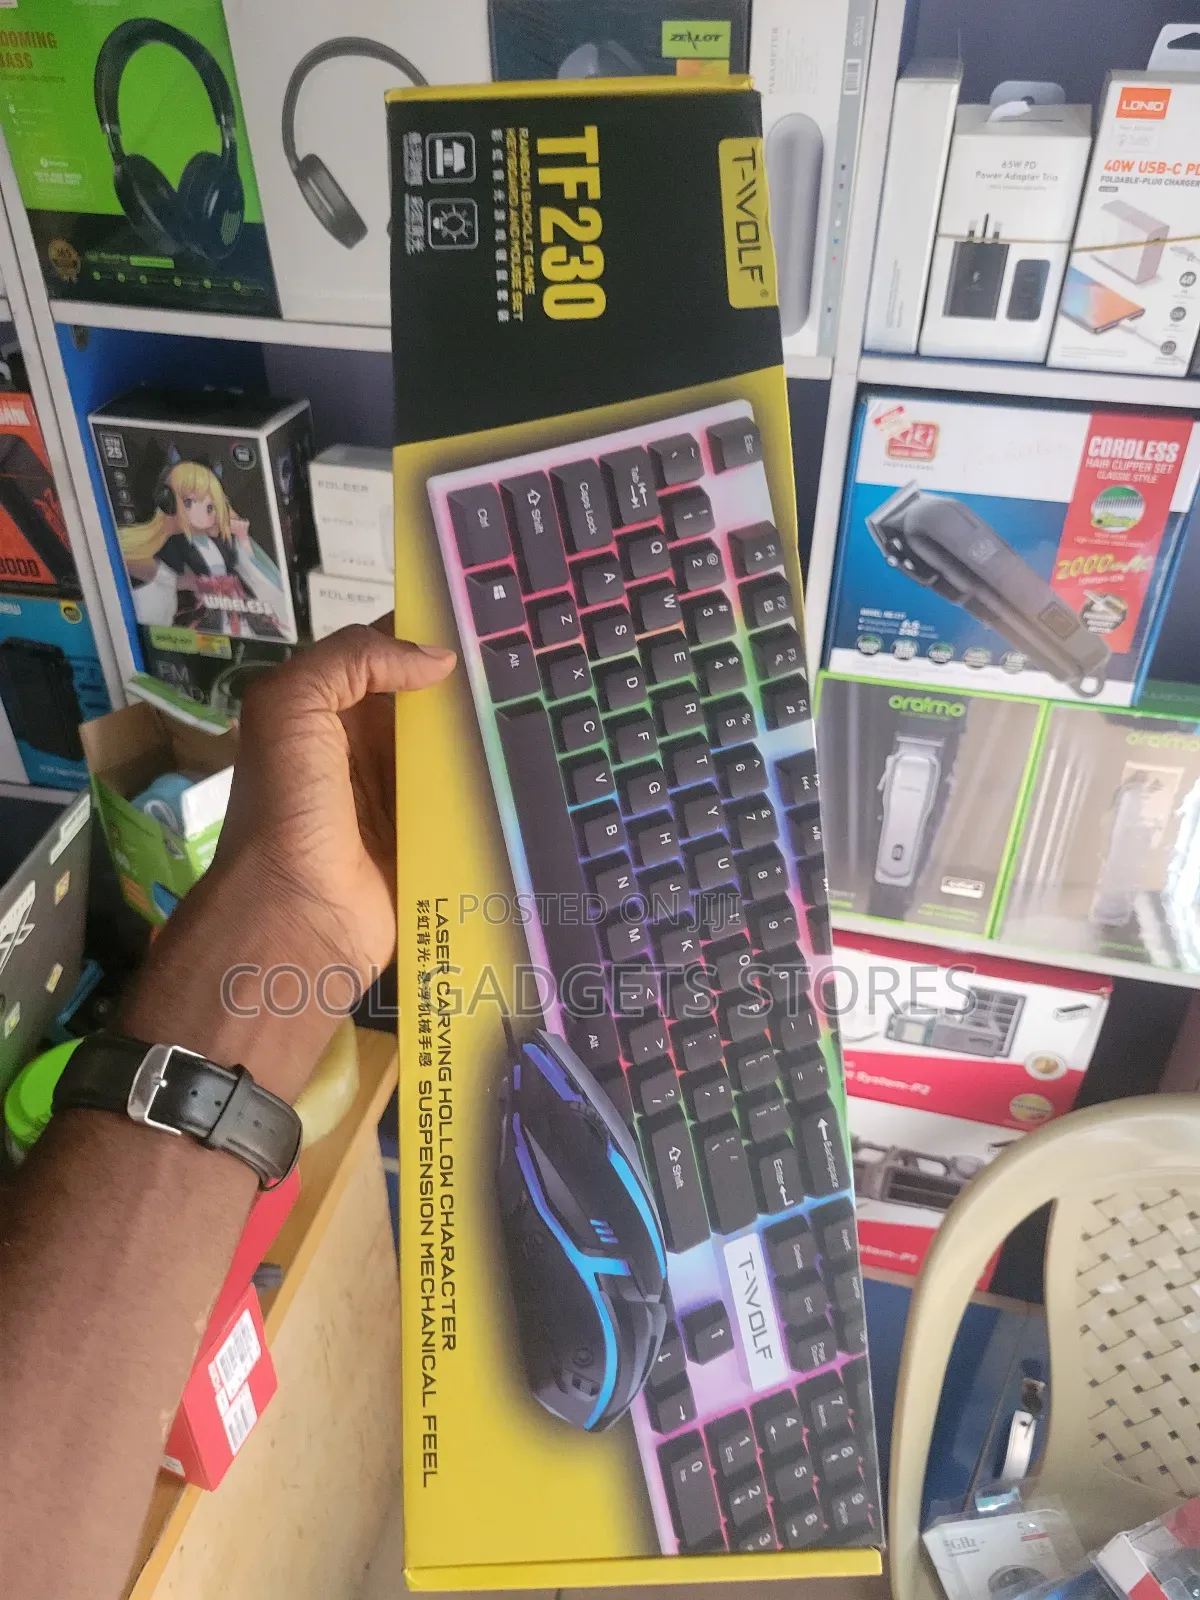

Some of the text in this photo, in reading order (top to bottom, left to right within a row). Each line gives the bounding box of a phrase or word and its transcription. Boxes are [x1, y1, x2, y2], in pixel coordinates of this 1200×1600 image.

[1121, 100, 1165, 113] LDNIO
[1024, 160, 1037, 170] PD
[1104, 159, 1135, 173] 40W
[1138, 160, 1183, 175] USB-C
[975, 170, 1059, 183] Power Adapter Trio
[1100, 175, 1163, 186] FOLDABLE-PLUG
[537, 125, 607, 321] TF230
[744, 435, 753, 454] Esc
[1087, 435, 1181, 463] CORDLESS
[1086, 457, 1174, 475] HAIR CLIPPER SET
[1132, 473, 1158, 484] STYLE
[580, 483, 597, 535] Caps Lock
[478, 509, 489, 527] Ctrl
[532, 509, 543, 534] Shift
[651, 542, 662, 554] Q
[693, 559, 702, 568] 2
[604, 573, 615, 583] A
[664, 594, 676, 607] W
[703, 608, 713, 616] 3
[561, 615, 572, 625] Z
[615, 625, 626, 635] S
[509, 654, 519, 668] Alt
[674, 652, 686, 663] E
[573, 668, 584, 679] X
[627, 677, 638, 688] D
[685, 703, 696, 715] R
[888, 695, 966, 718] oraimo
[584, 721, 595, 732] C
[726, 719, 736, 727] 5
[638, 732, 649, 740] F
[697, 755, 707, 764] T
[596, 773, 607, 782] V
[649, 782, 660, 794] G
[708, 806, 718, 815] Y
[606, 824, 617, 835] B
[660, 833, 671, 844] H
[718, 858, 729, 869] U
[618, 877, 629, 888] N
[769, 921, 778, 929] 9
[629, 928, 640, 942] M
[681, 940, 693, 952] K
[739, 955, 750, 966] O
[694, 993, 704, 1003] L
[749, 1004, 759, 1012] P
[589, 1035, 598, 1049] Alt
[435, 898, 457, 1352] LASER CARVING HOLLOW CHARACTER
[823, 1137, 839, 1187] Backspace
[673, 1165, 684, 1189] Shift
[774, 1159, 784, 1185] Enter
[418, 1080, 438, 1488] SUSPENSION MECHANICAL FEEL
[831, 1396, 843, 1404] 7
[786, 1418, 797, 1427] 4
[740, 1437, 750, 1446] 1
[692, 1461, 702, 1472] 0
[795, 1467, 806, 1477] 5
[749, 1486, 760, 1498] 2
[759, 1533, 771, 1546] 3
